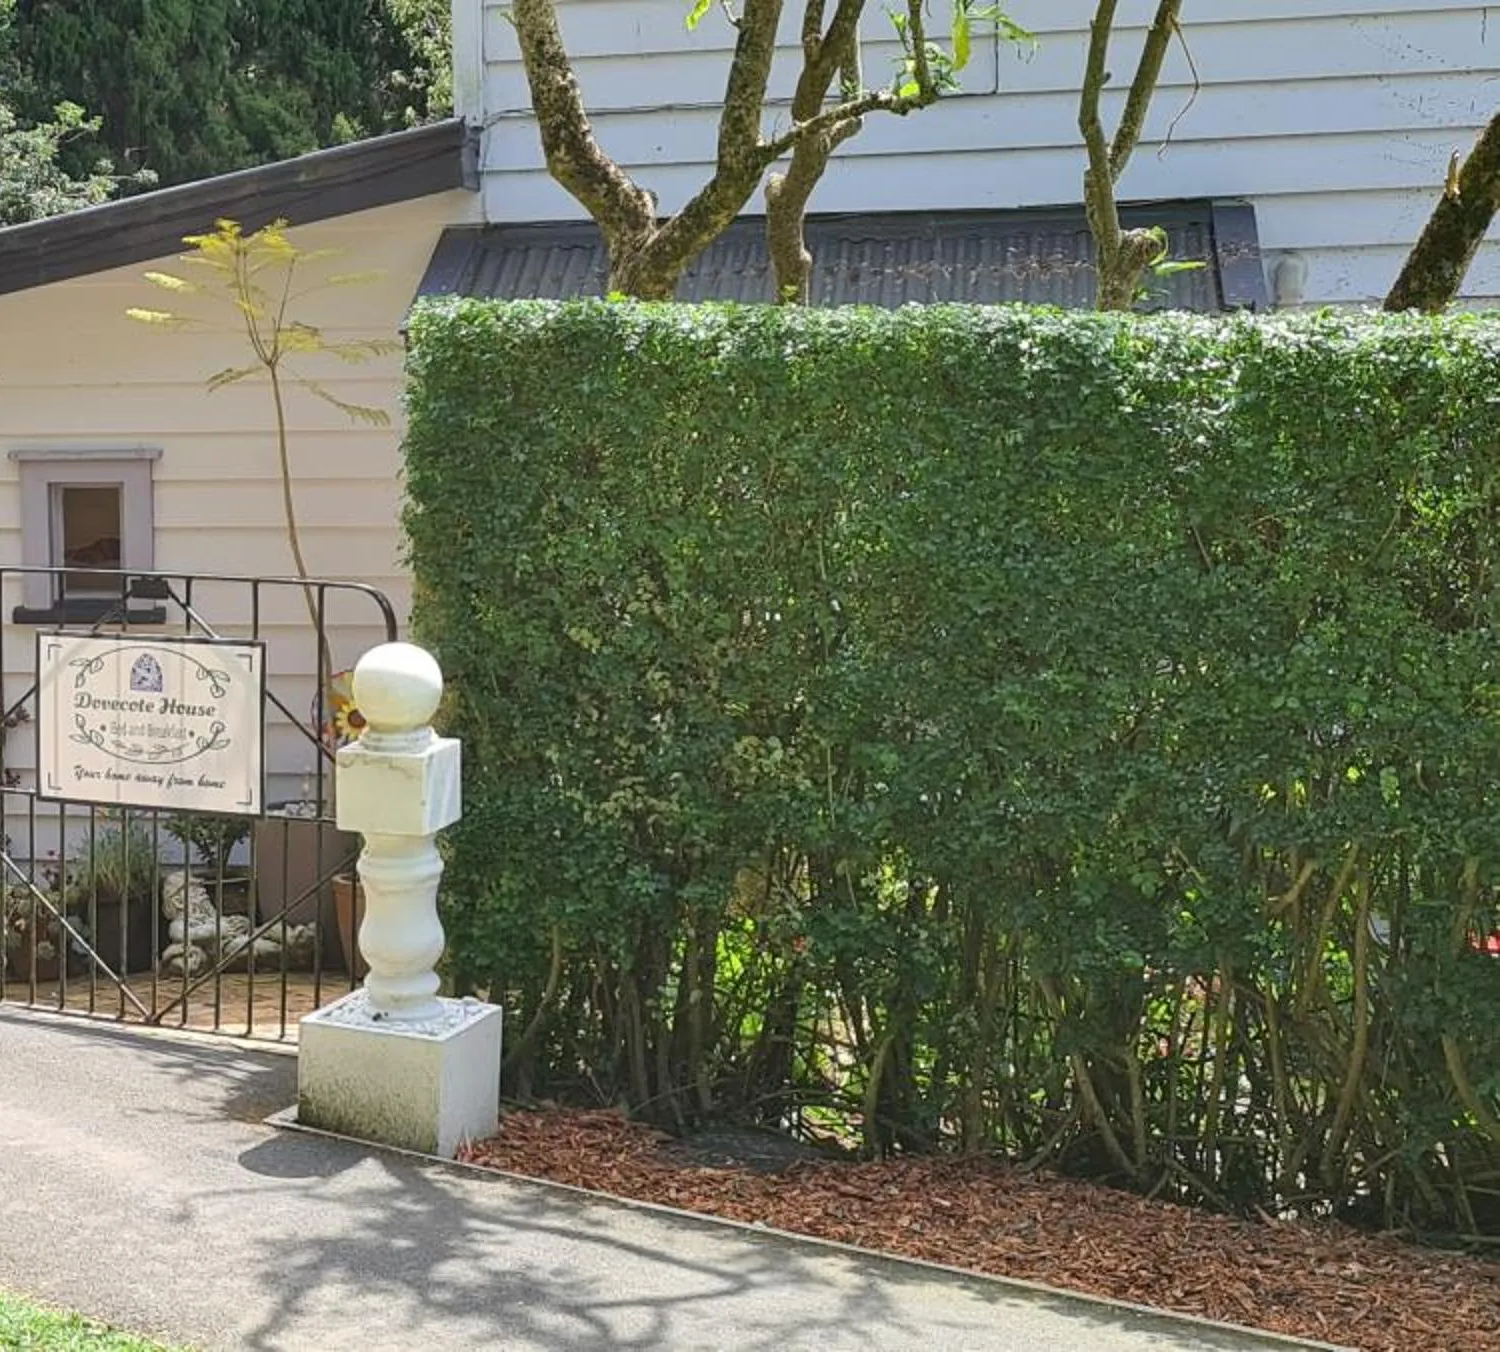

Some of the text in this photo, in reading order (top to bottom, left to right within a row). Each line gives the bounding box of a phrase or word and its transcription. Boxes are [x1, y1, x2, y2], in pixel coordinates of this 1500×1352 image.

[74, 691, 217, 717] Dovecote House
[73, 764, 226, 790] Your home away from home
